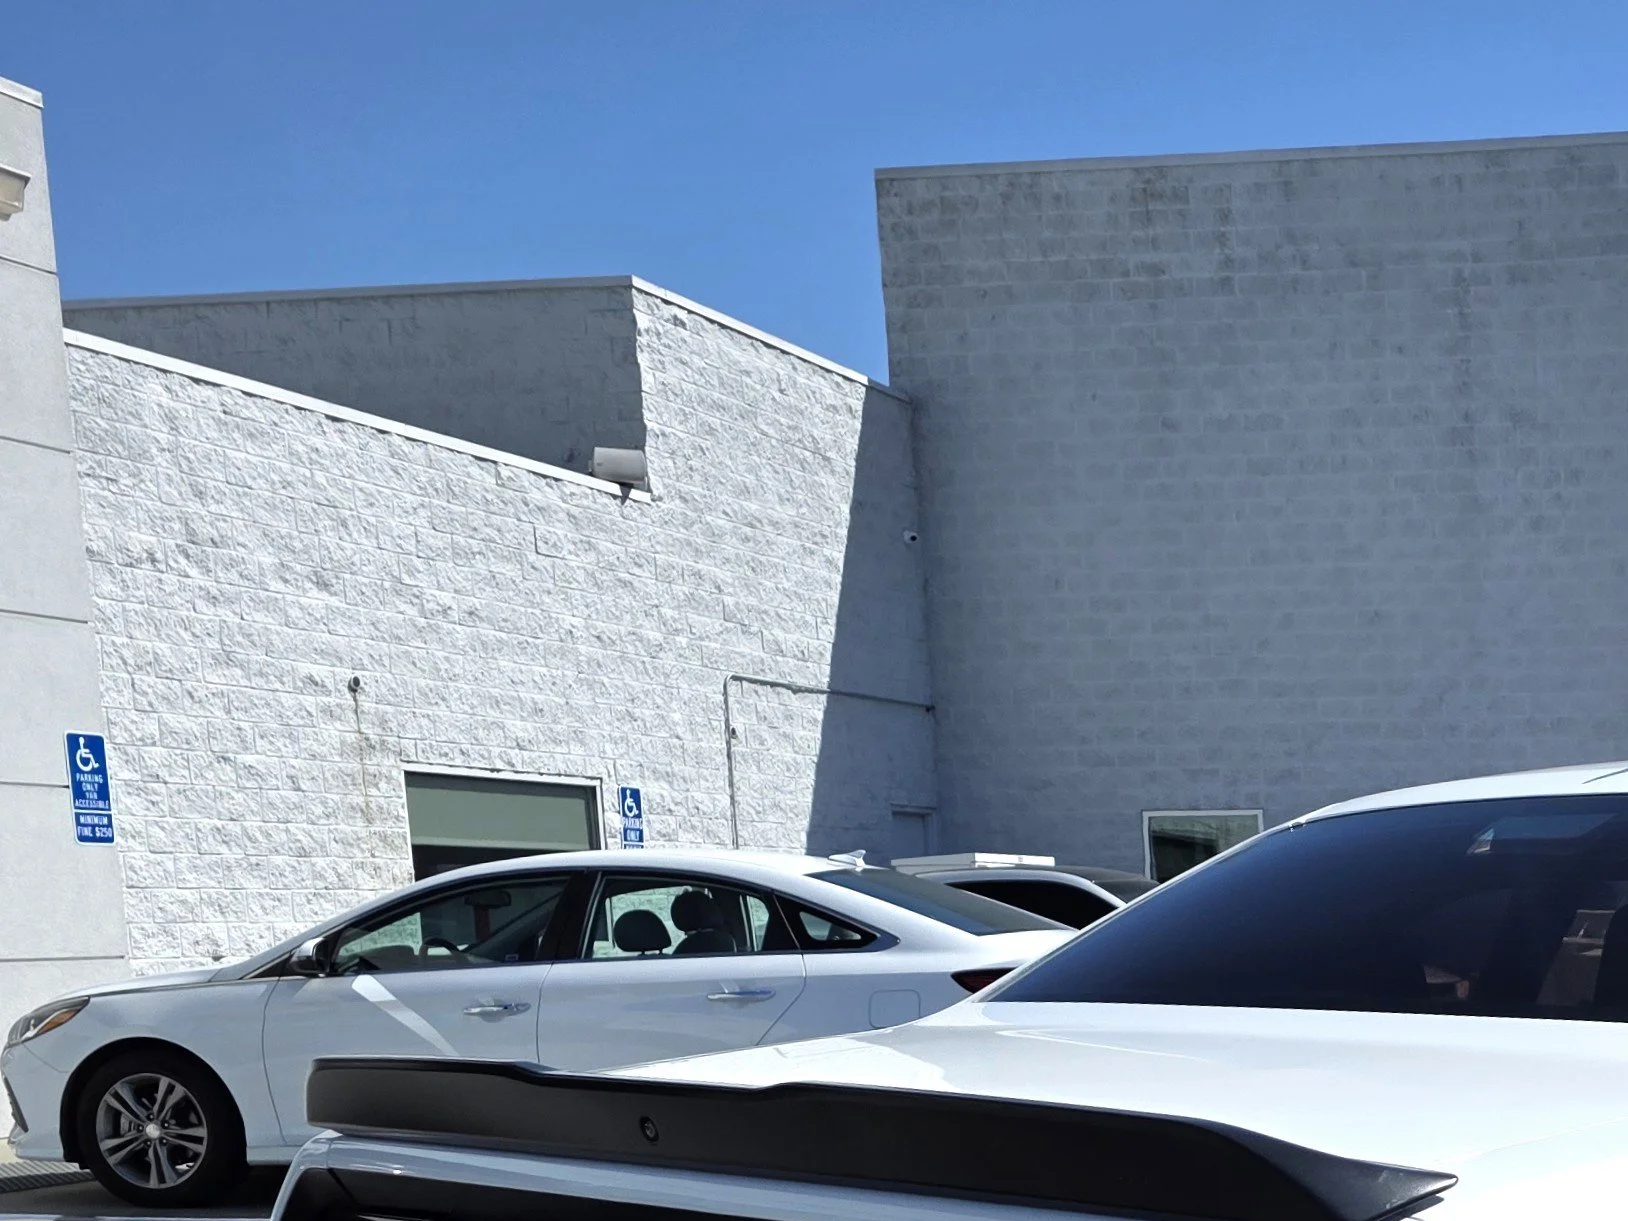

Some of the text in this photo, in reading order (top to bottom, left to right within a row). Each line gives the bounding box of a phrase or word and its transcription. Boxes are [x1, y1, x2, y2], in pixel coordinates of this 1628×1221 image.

[76, 773, 103, 783] PARKING
[82, 783, 98, 791] ONLY
[80, 815, 107, 825] MINIMUM
[78, 827, 112, 837] FINE $250
